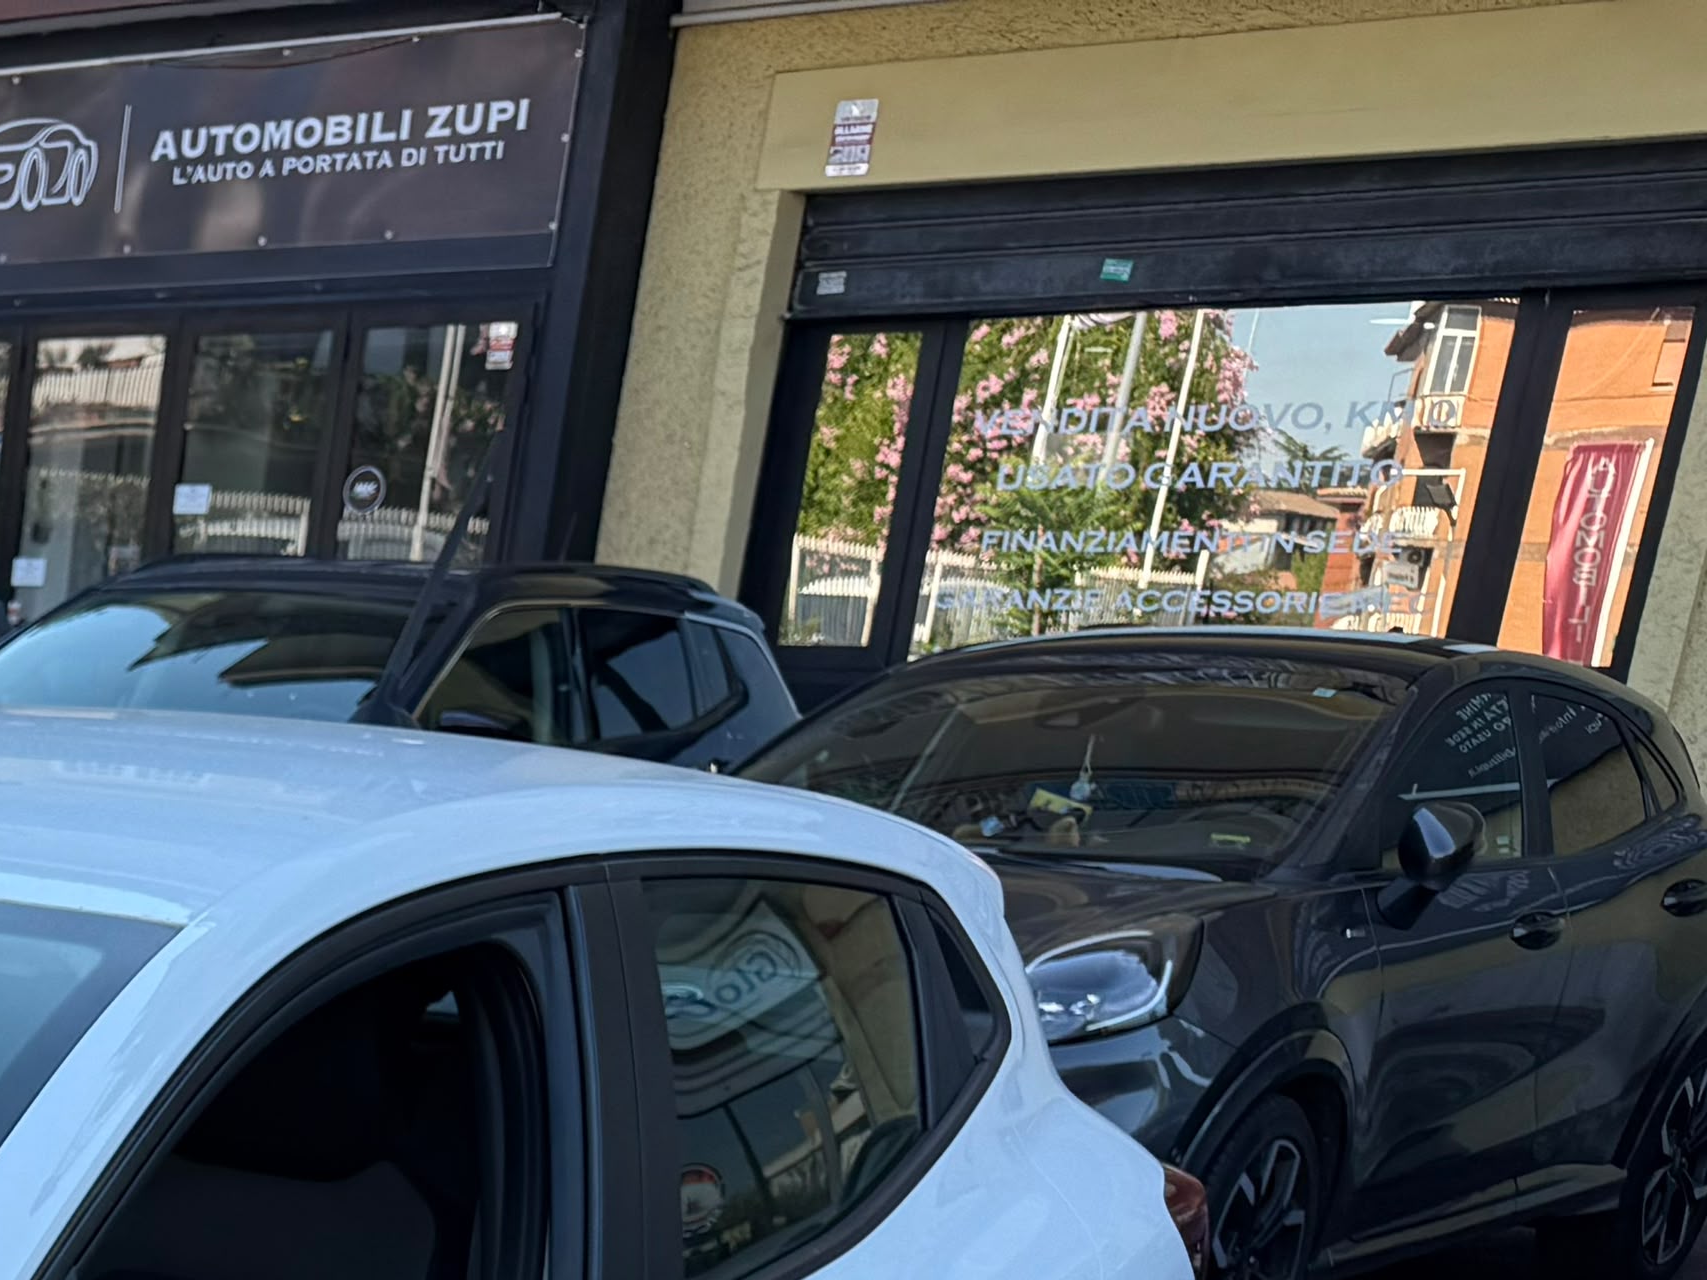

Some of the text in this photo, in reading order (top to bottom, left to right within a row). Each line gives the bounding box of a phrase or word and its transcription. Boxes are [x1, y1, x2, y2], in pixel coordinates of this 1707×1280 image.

[151, 98, 531, 162] AUTOMOBILI ZUPI
[173, 141, 505, 185] L'AUTO A PORTATA DI TUTTI
[974, 406, 1153, 436] VENDITA
[1160, 402, 1332, 433] NUOVO,
[996, 459, 1403, 490] USATO GARANTITO
[981, 529, 1252, 554] FINANZIAMENTI
[1304, 530, 1402, 554] SEDE
